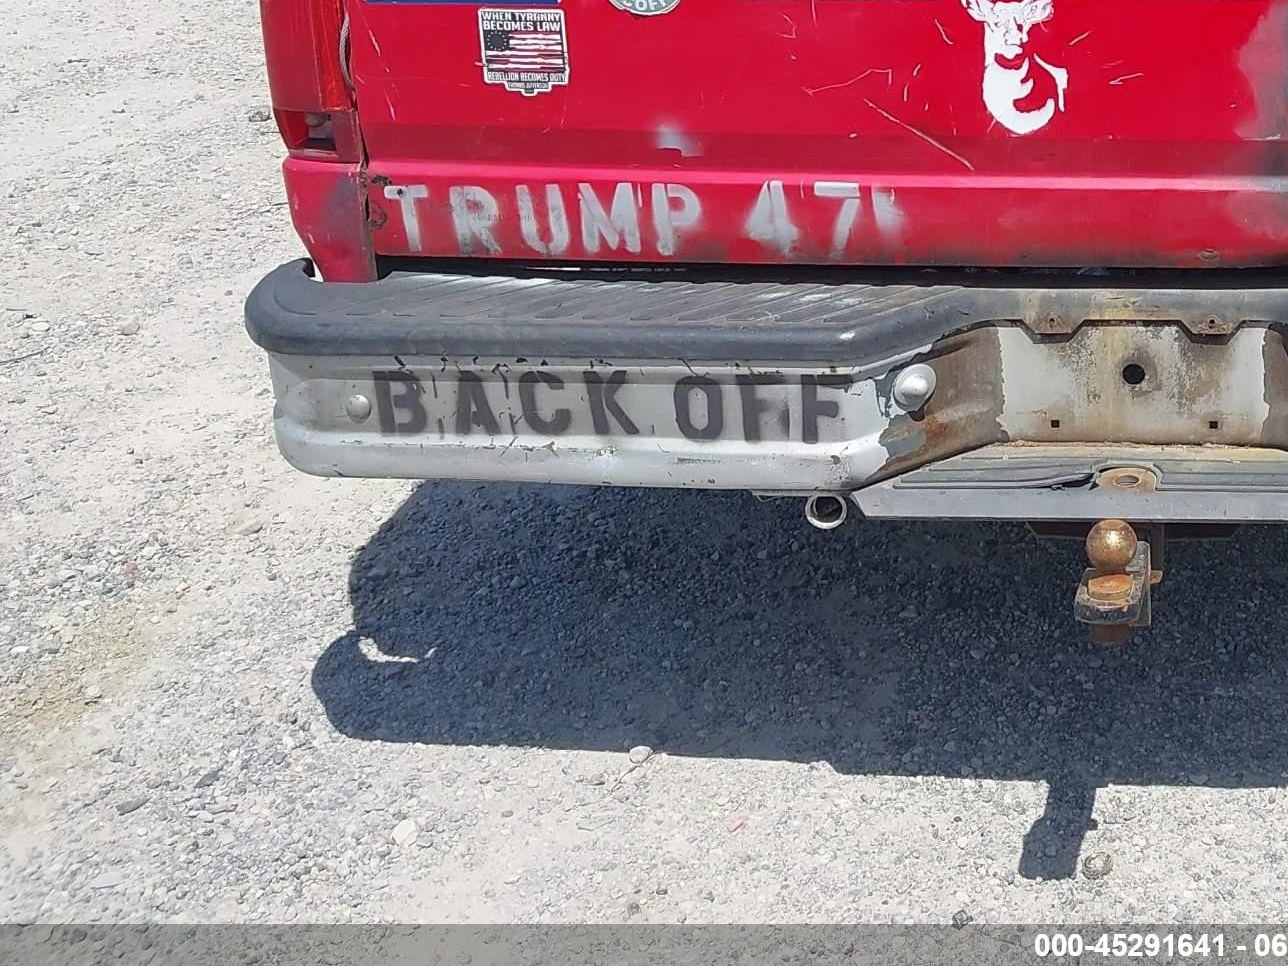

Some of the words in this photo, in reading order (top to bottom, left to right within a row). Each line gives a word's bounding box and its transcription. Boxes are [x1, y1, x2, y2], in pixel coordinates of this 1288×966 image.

[481, 11, 512, 21] WHEN
[515, 12, 560, 22] TYRANNY
[483, 20, 534, 31] BECOMES
[537, 21, 560, 31] LAW
[383, 181, 702, 256] TRUMP
[373, 369, 640, 436] BACK
[674, 373, 853, 444] OFF
